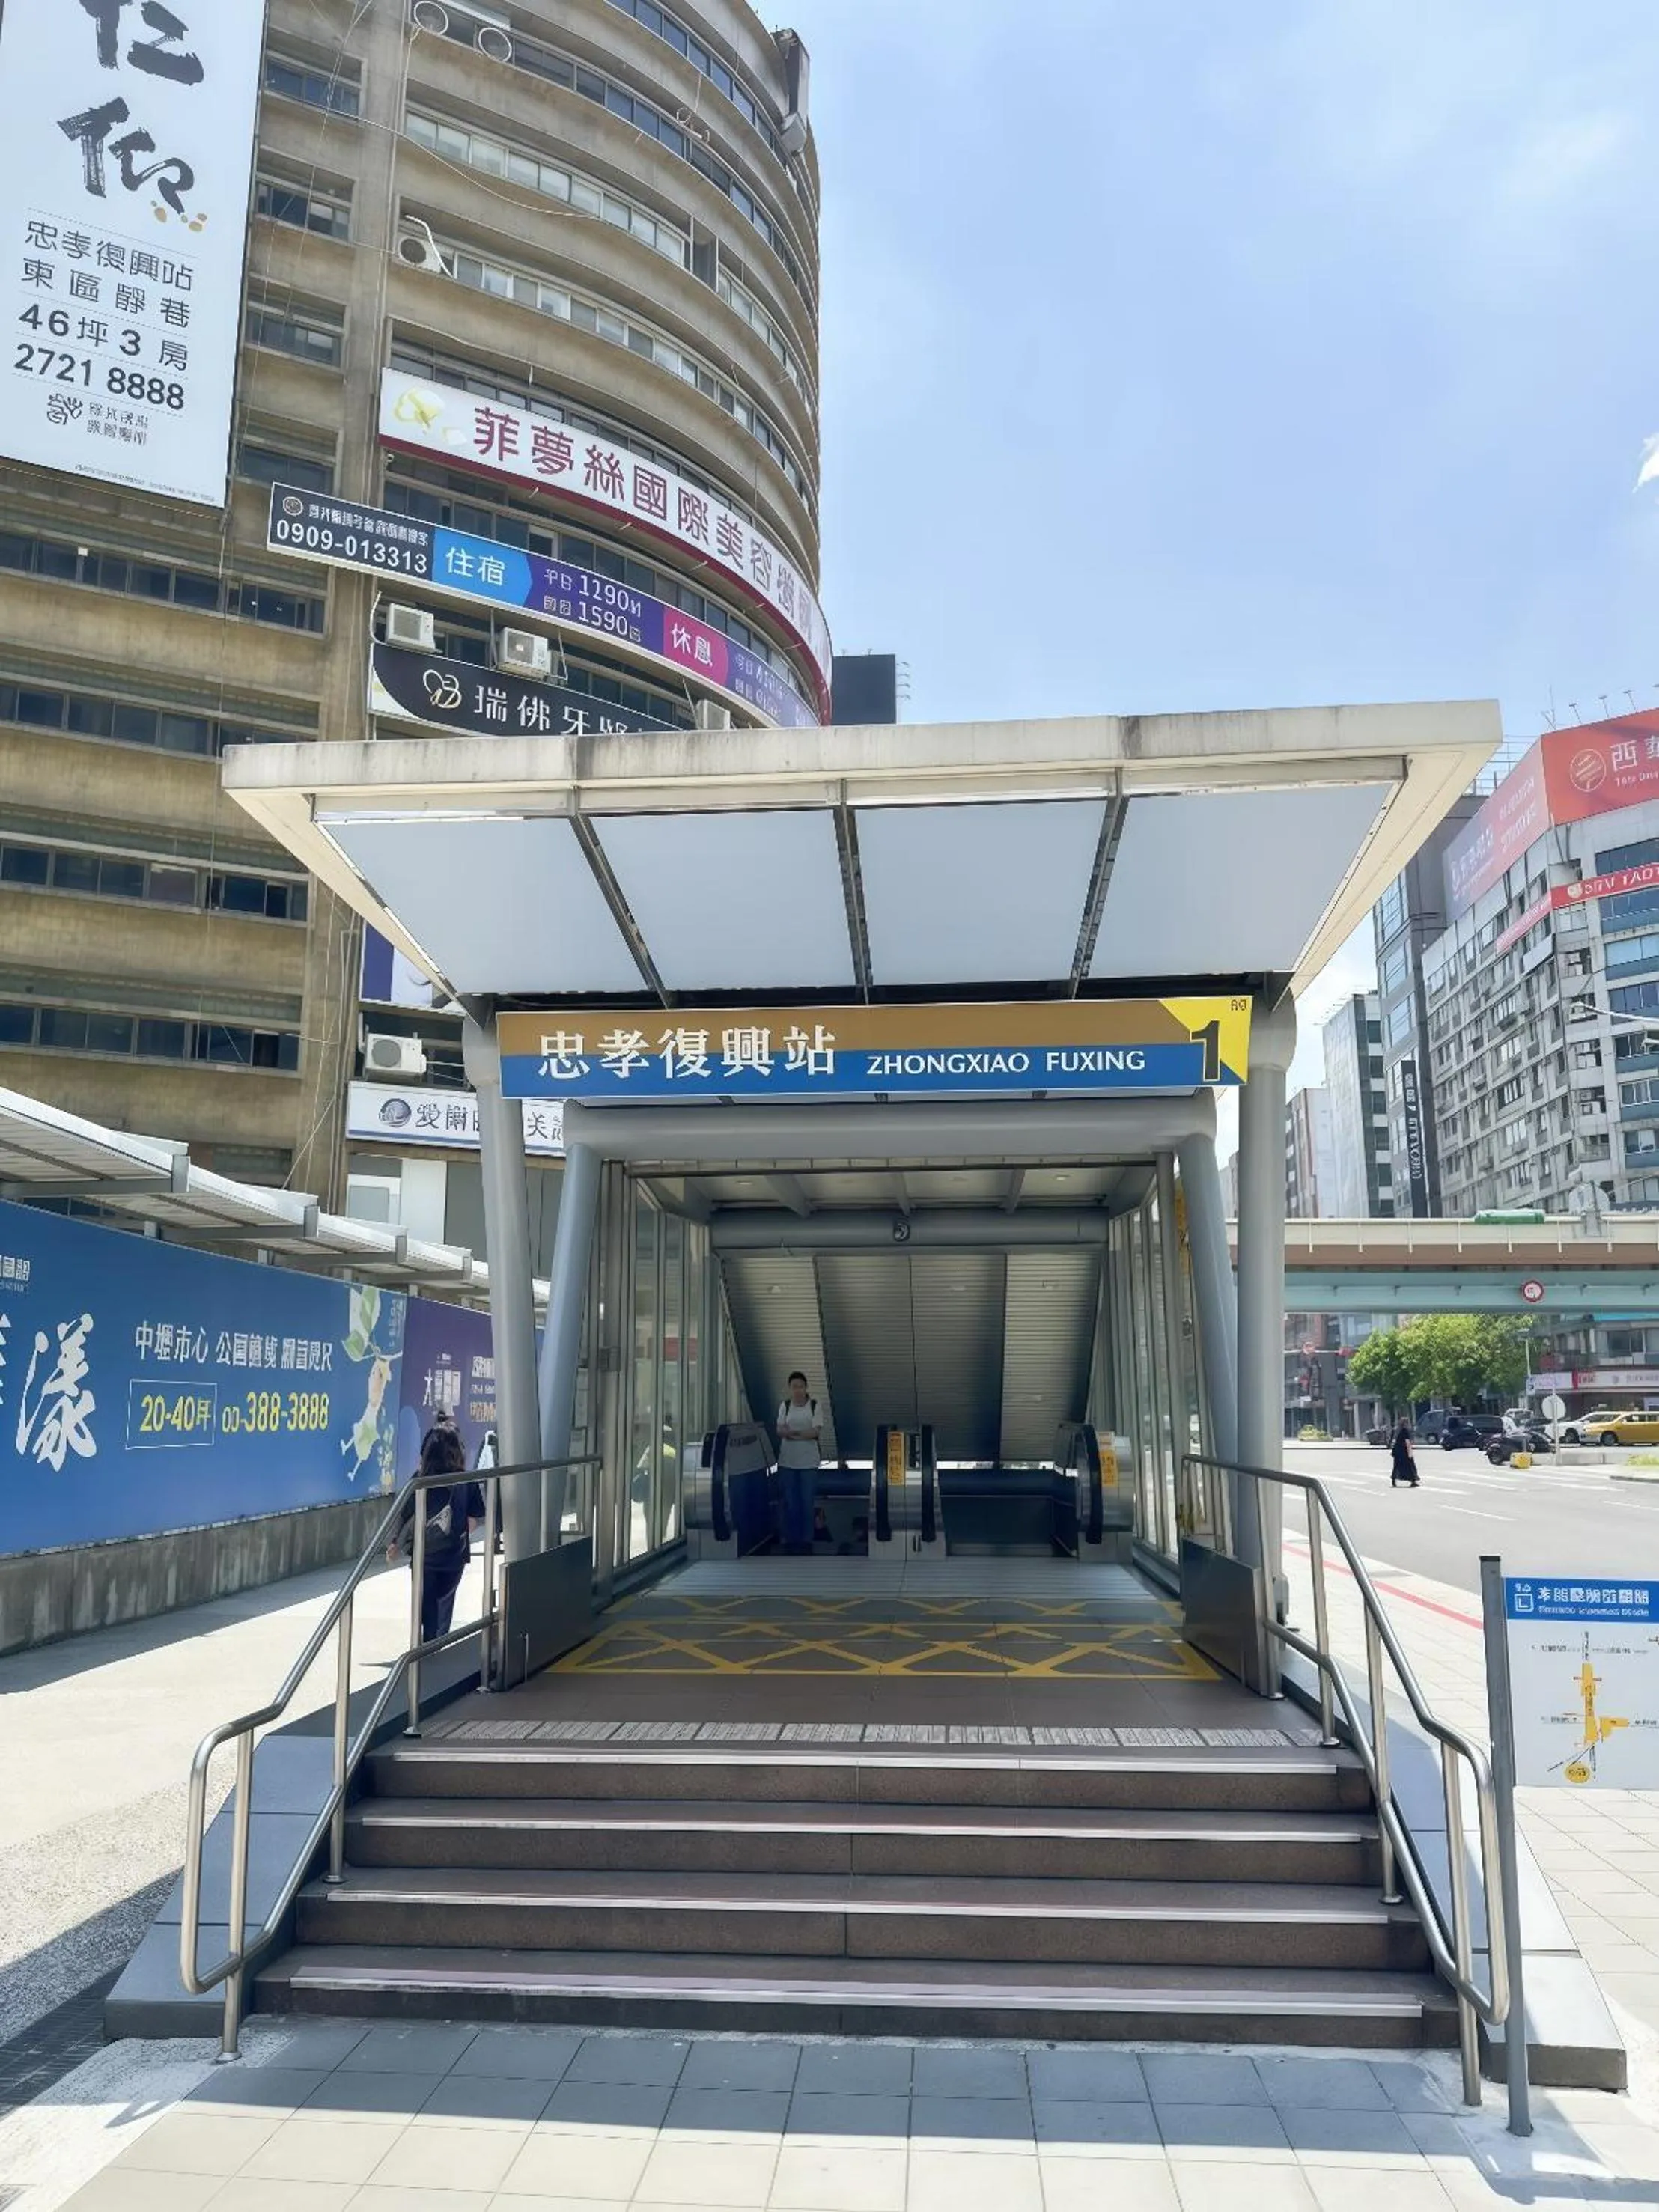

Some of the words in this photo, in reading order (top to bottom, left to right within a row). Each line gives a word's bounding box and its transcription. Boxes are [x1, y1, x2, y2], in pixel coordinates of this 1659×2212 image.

[25, 221, 193, 291] 忠孝復興站
[13, 343, 91, 386] 2721
[106, 367, 184, 410] 8888
[276, 520, 427, 573] 0909-013313
[445, 546, 505, 586] 住宿
[538, 1024, 835, 1079] 忠孝復興站
[866, 1052, 1030, 1075] ZHONGXIAO
[1047, 1050, 1145, 1072] FUXING
[1190, 1019, 1220, 1081] 1
